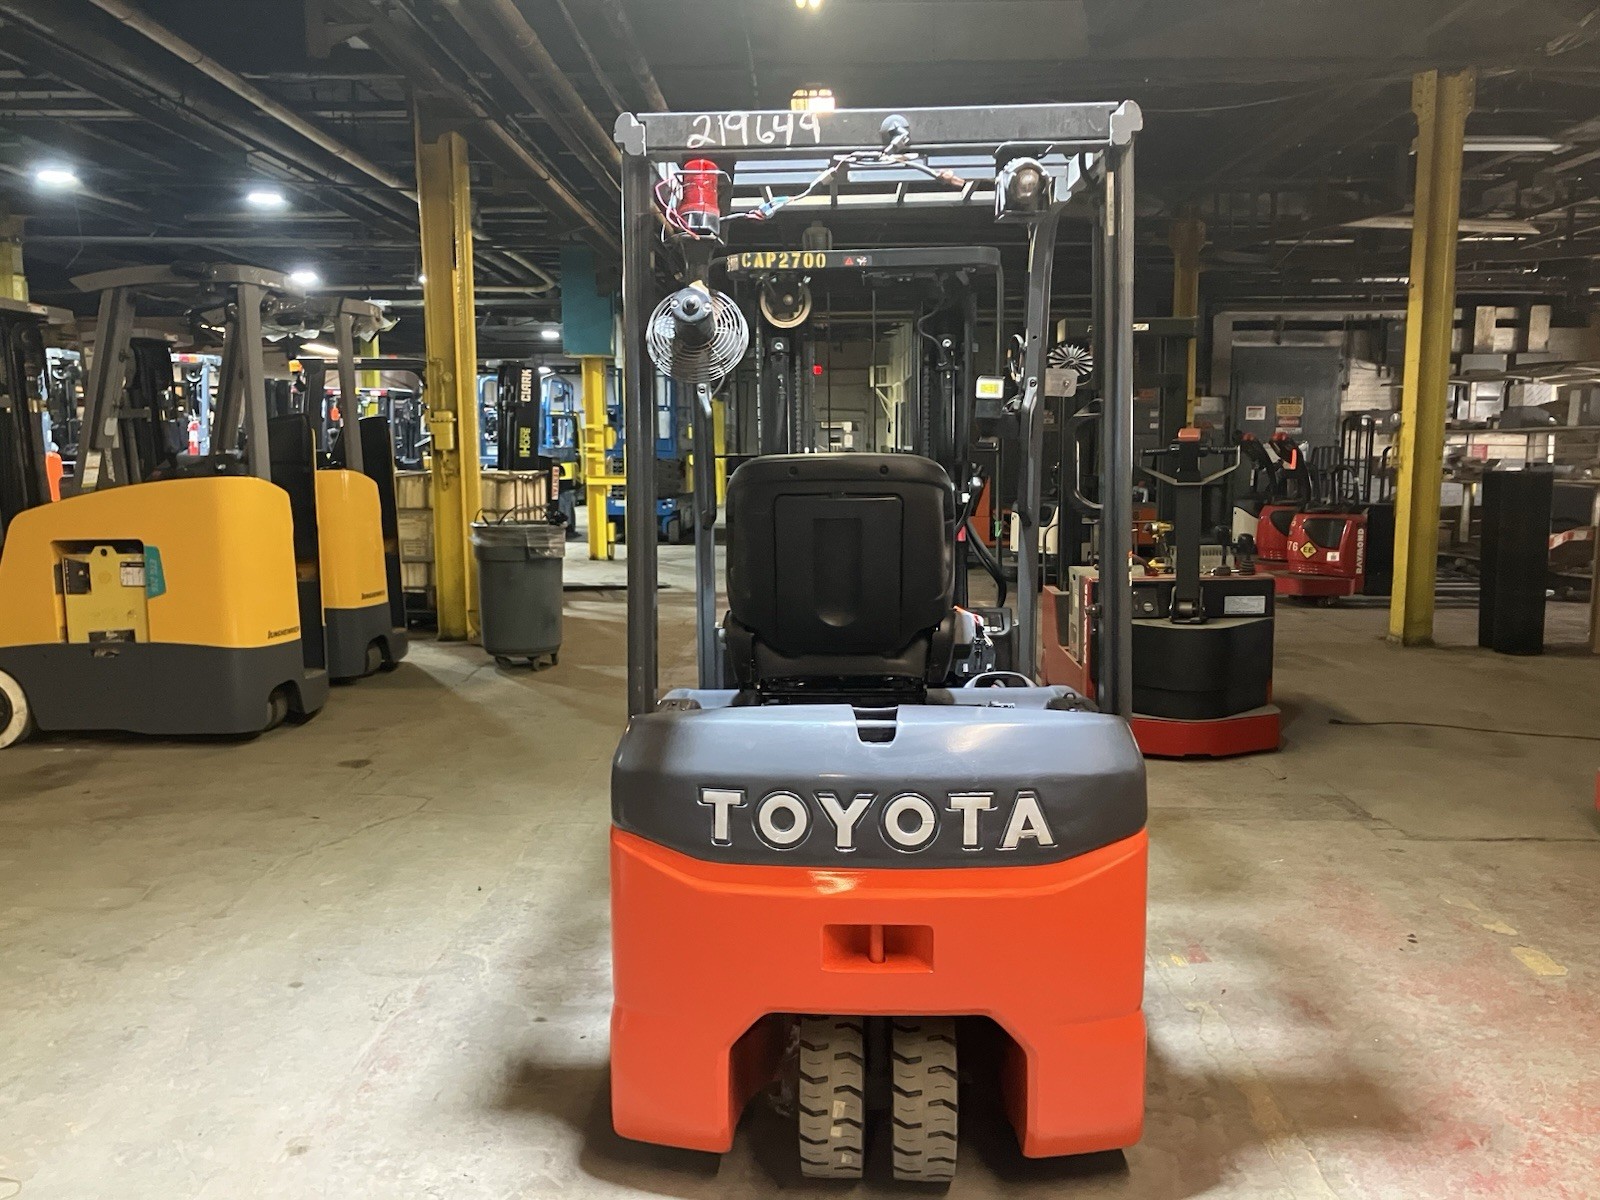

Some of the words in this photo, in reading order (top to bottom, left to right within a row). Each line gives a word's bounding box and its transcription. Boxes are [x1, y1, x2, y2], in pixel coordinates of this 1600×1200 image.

[686, 112, 821, 149] 219649
[520, 368, 532, 403] CLARK
[1356, 528, 1365, 574] RAYMOND
[699, 789, 1057, 851] TOYOTA
